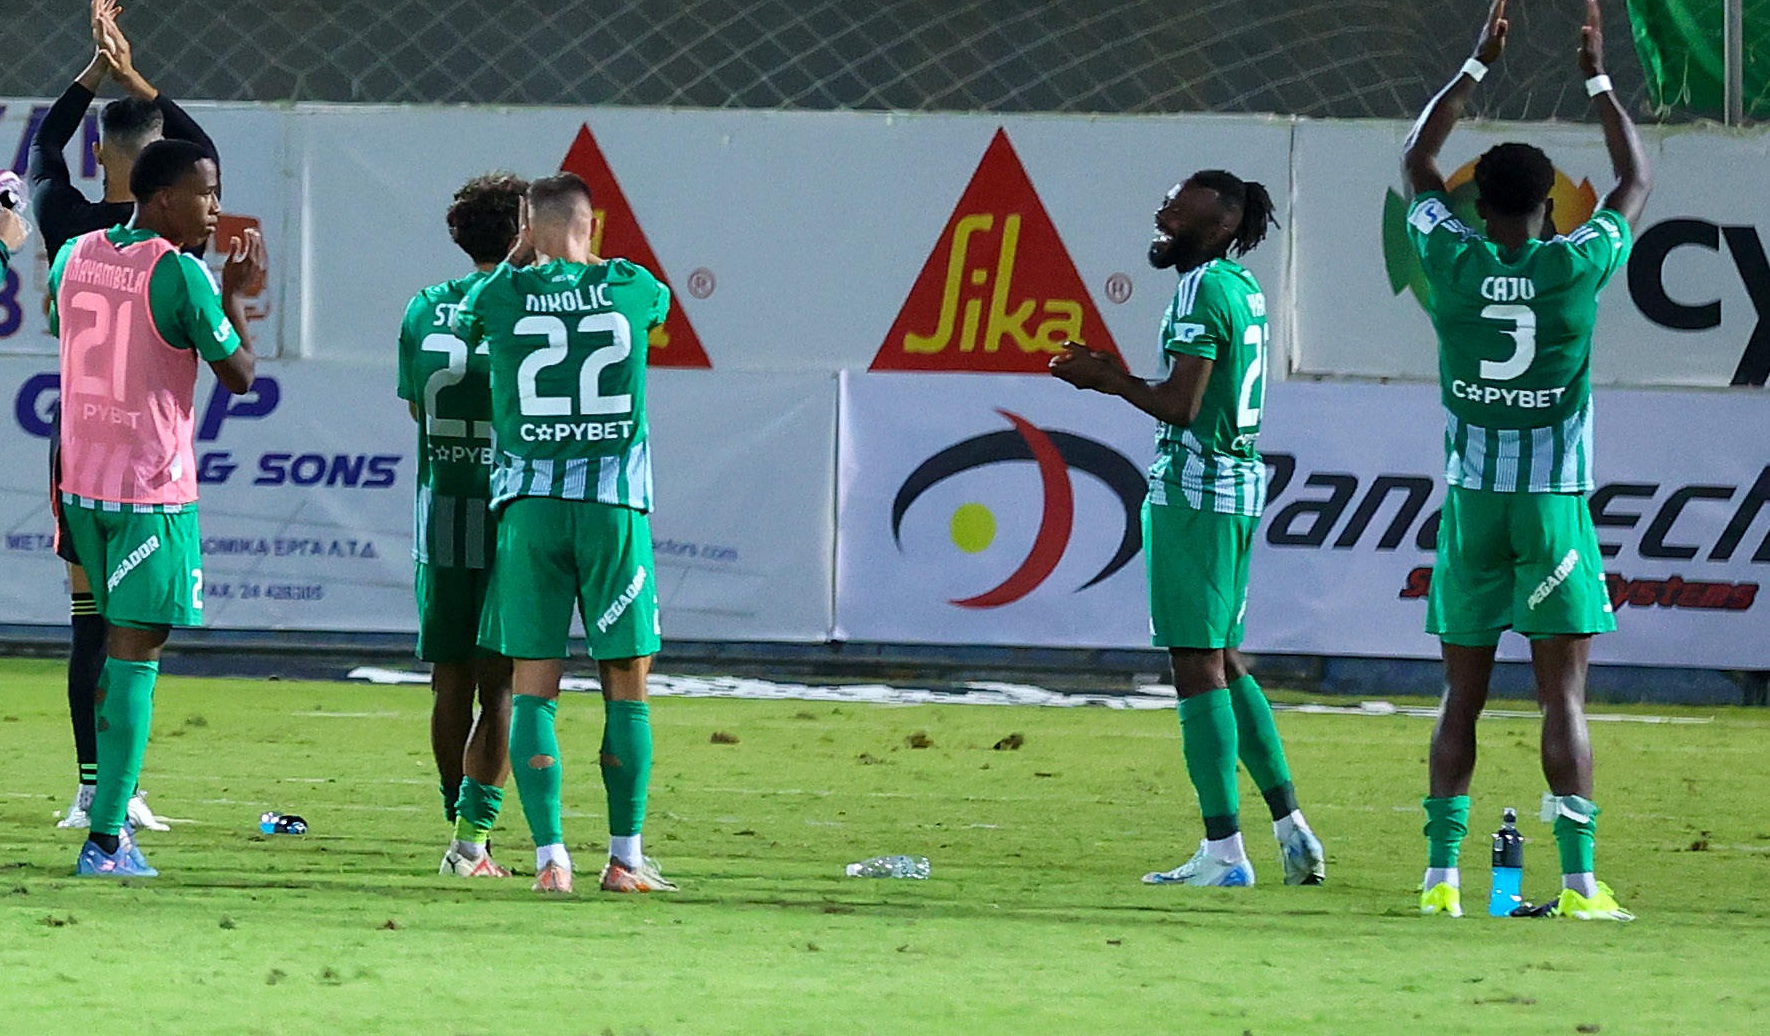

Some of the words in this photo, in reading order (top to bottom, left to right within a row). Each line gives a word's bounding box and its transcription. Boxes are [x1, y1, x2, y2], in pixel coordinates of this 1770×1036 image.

[525, 282, 613, 313] NIKOLIC
[902, 214, 1087, 354] Sika
[1481, 276, 1536, 302] CAJU
[70, 290, 133, 403] 21
[512, 311, 633, 417] 22
[1479, 303, 1537, 381] 3
[253, 452, 404, 489] SONS
[596, 564, 648, 634] PEGADOR
